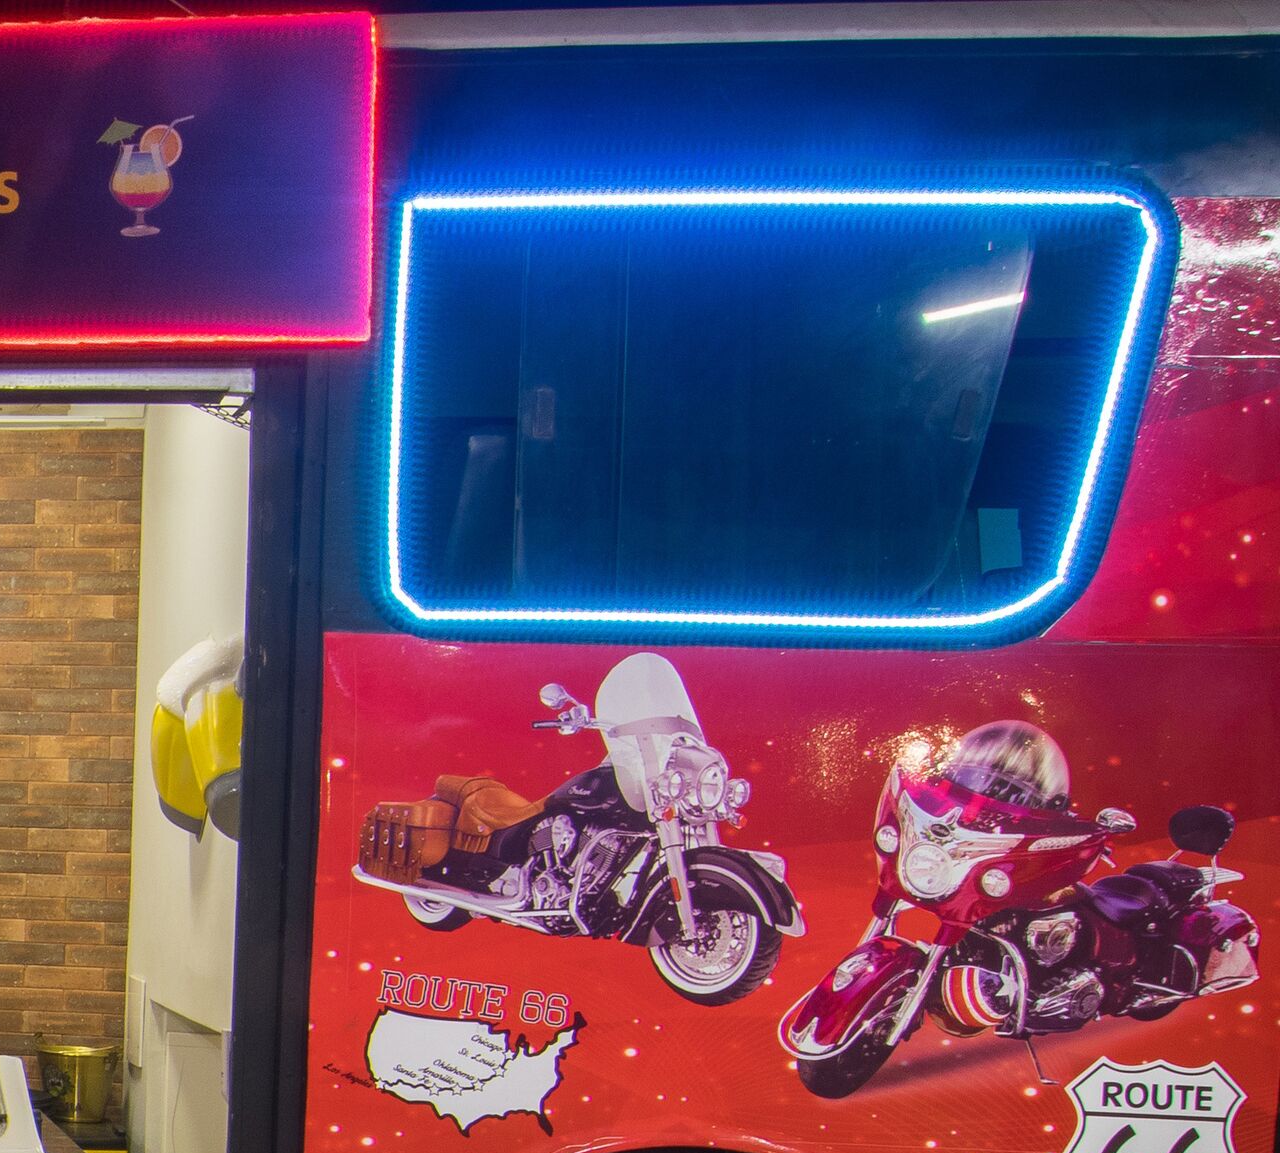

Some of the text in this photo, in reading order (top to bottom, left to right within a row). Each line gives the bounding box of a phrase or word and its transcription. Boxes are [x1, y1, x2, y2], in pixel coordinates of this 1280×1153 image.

[377, 970, 569, 1027] ROUTE 66
[471, 1034, 503, 1053] Chicago
[393, 1064, 417, 1080] Santa
[418, 1065, 456, 1086] Amarillo
[433, 1058, 474, 1082] Oklahoma
[1101, 1081, 1213, 1112] ROUTE
